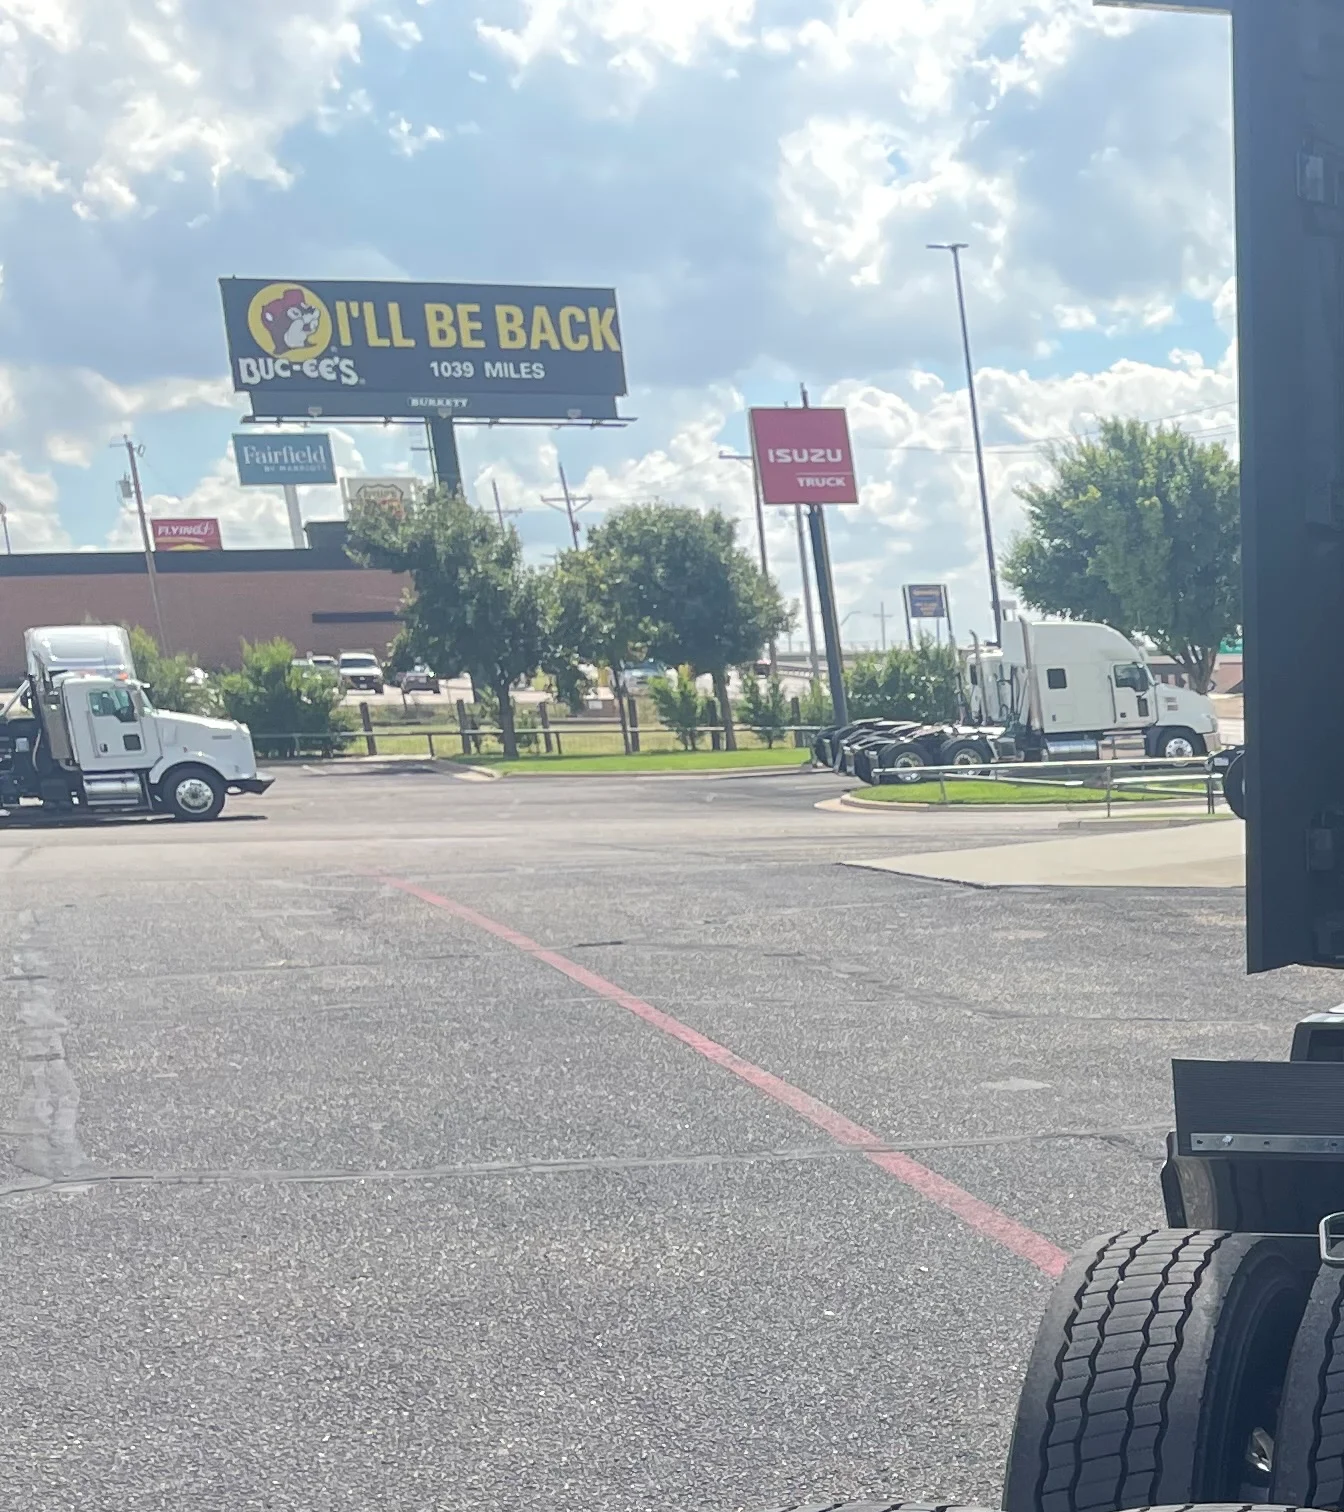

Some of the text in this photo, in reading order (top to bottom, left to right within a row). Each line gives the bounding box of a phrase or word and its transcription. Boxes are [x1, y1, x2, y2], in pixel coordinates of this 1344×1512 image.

[335, 300, 621, 352] I'LL BE BACK
[238, 356, 359, 386] BUC-EE'S
[430, 361, 546, 379] 1039 MILES
[243, 445, 326, 465] Fairfield
[767, 448, 843, 463] ISUZU
[796, 476, 846, 488] TRUCK
